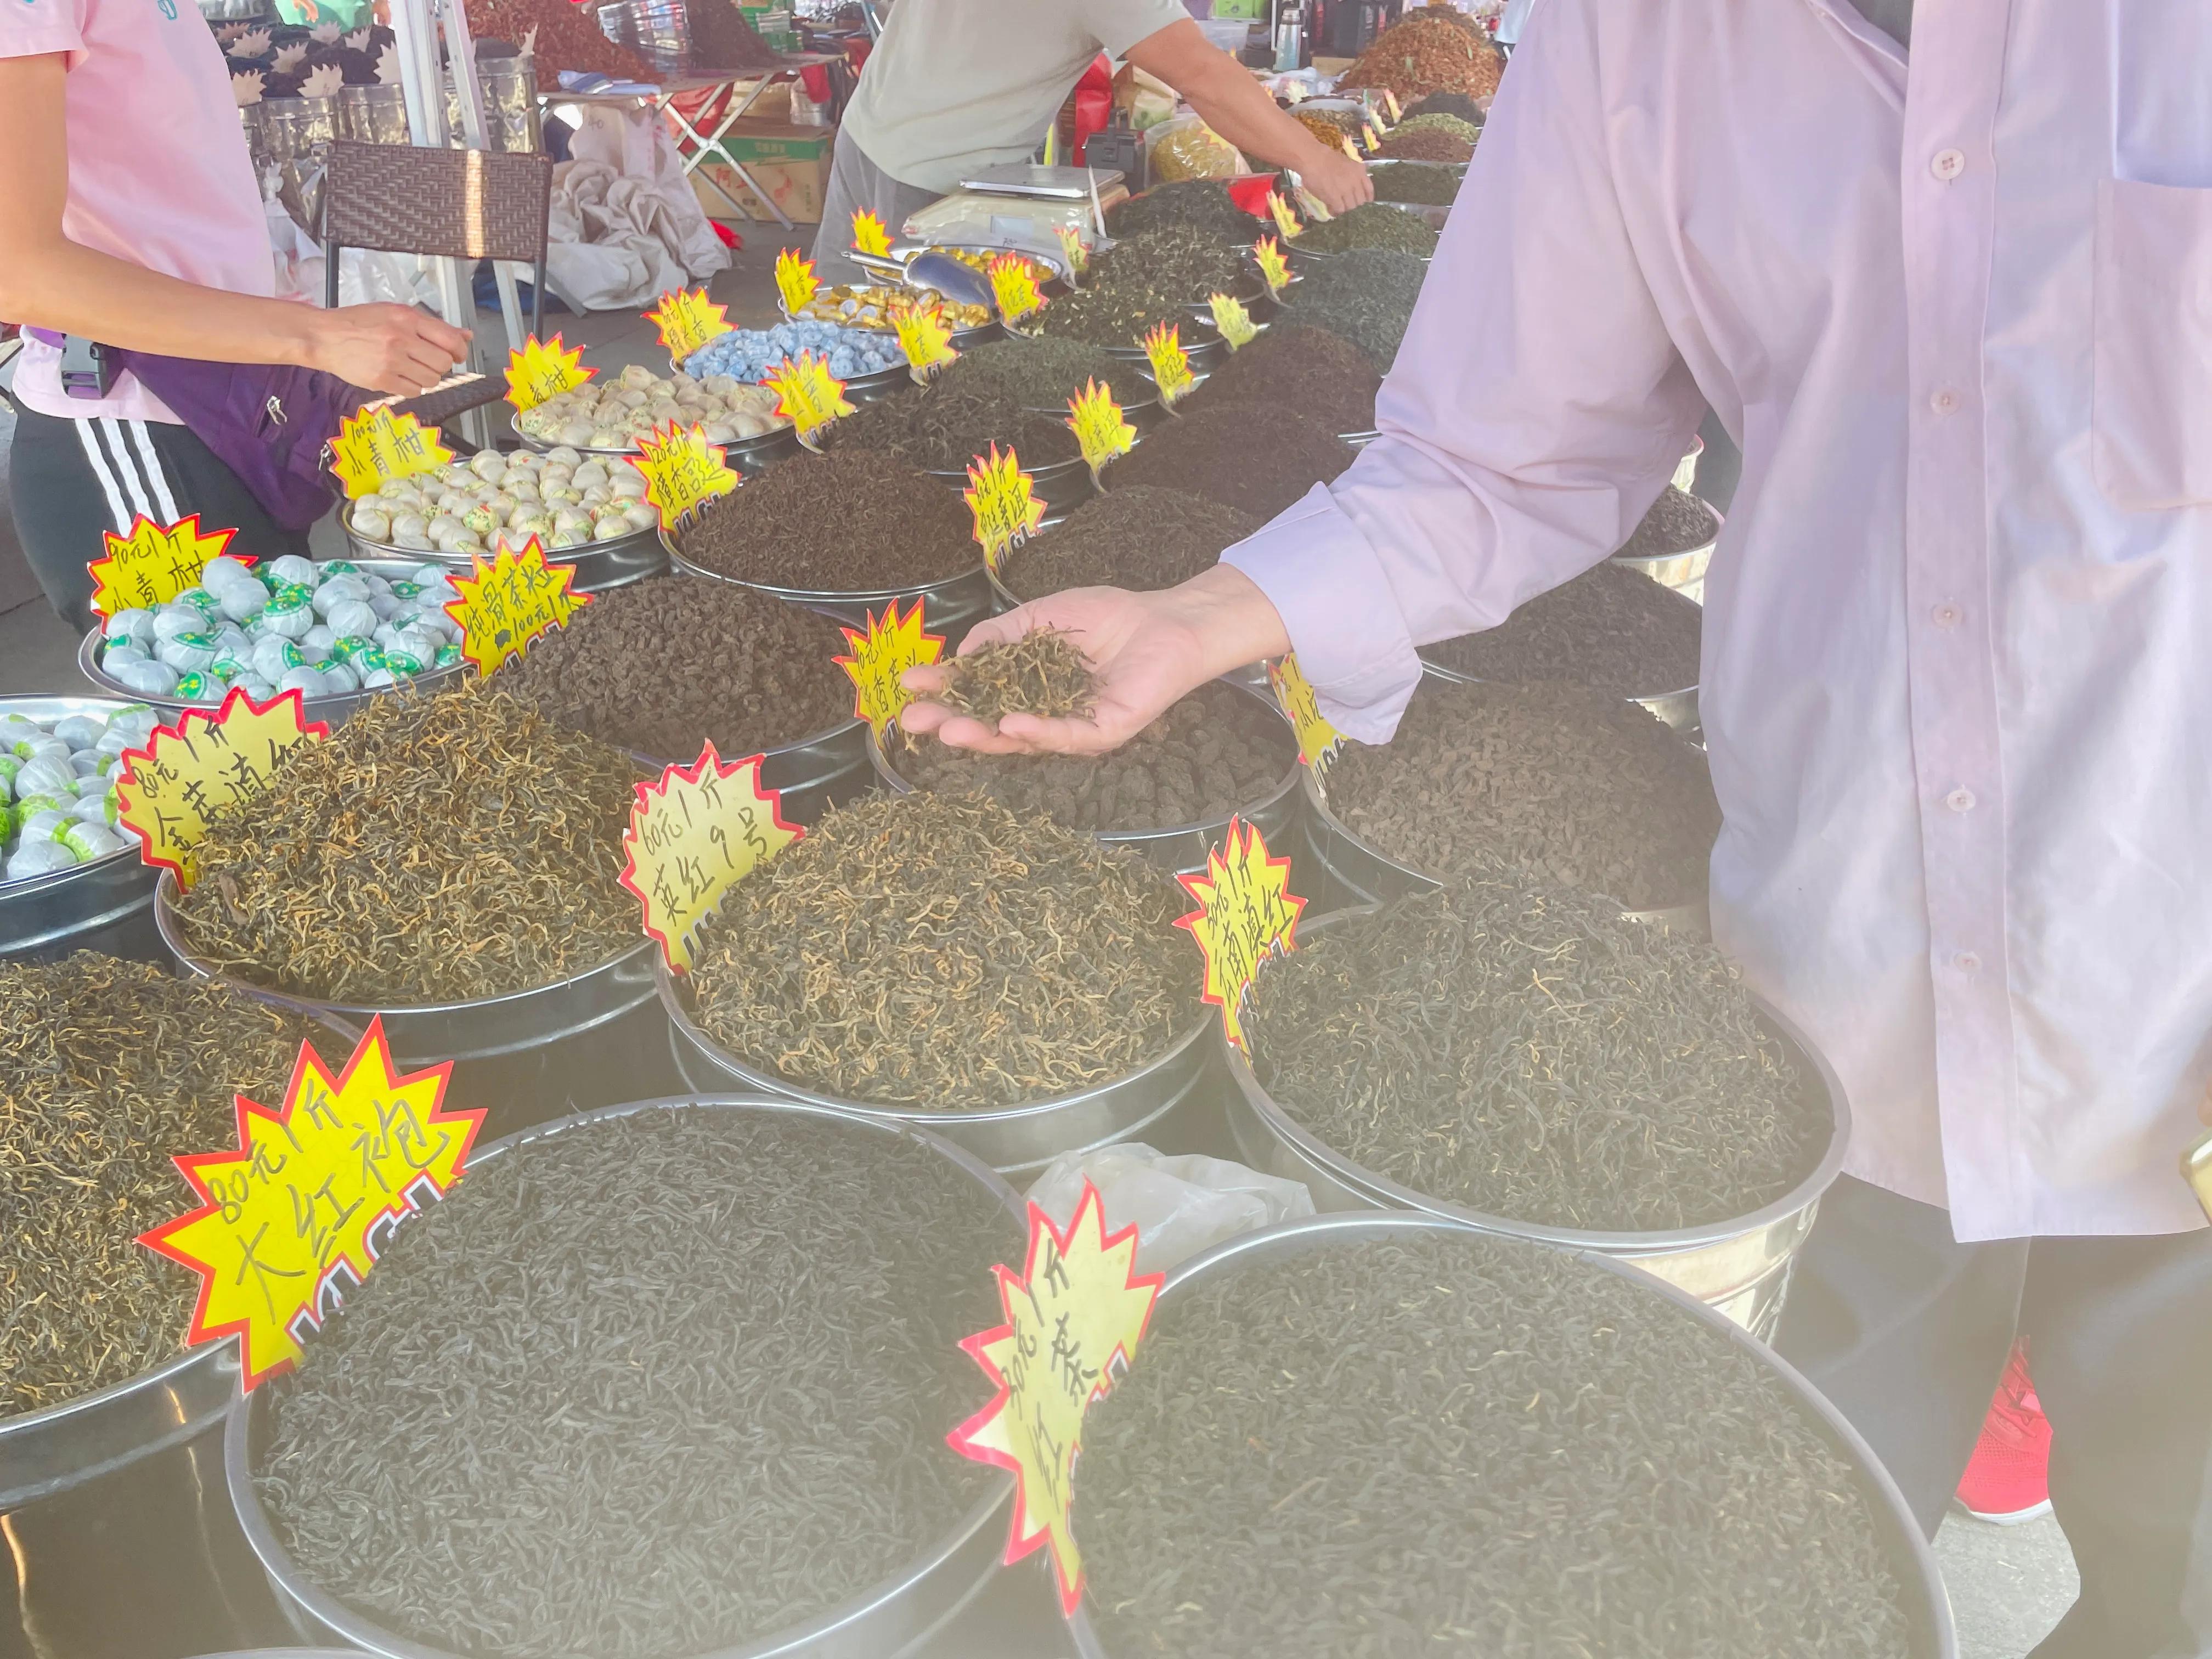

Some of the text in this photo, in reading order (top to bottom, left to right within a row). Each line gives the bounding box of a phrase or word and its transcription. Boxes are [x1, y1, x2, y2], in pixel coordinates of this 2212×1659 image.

[345, 427, 426, 477] 小青柑
[351, 412, 393, 446] 100元1斤
[647, 429, 693, 469] 120元1斤
[109, 524, 182, 572] 90元1斤
[112, 549, 205, 613] 小青柑
[131, 715, 229, 799] 80元1斤
[640, 765, 723, 856] 60元1斤
[653, 806, 768, 927] 英红9号
[1214, 883, 1294, 1008] 云南滇红
[207, 1077, 344, 1224] 80元1斤
[235, 1098, 451, 1325] 大红袍
[1026, 1311, 1099, 1515] 红茶
